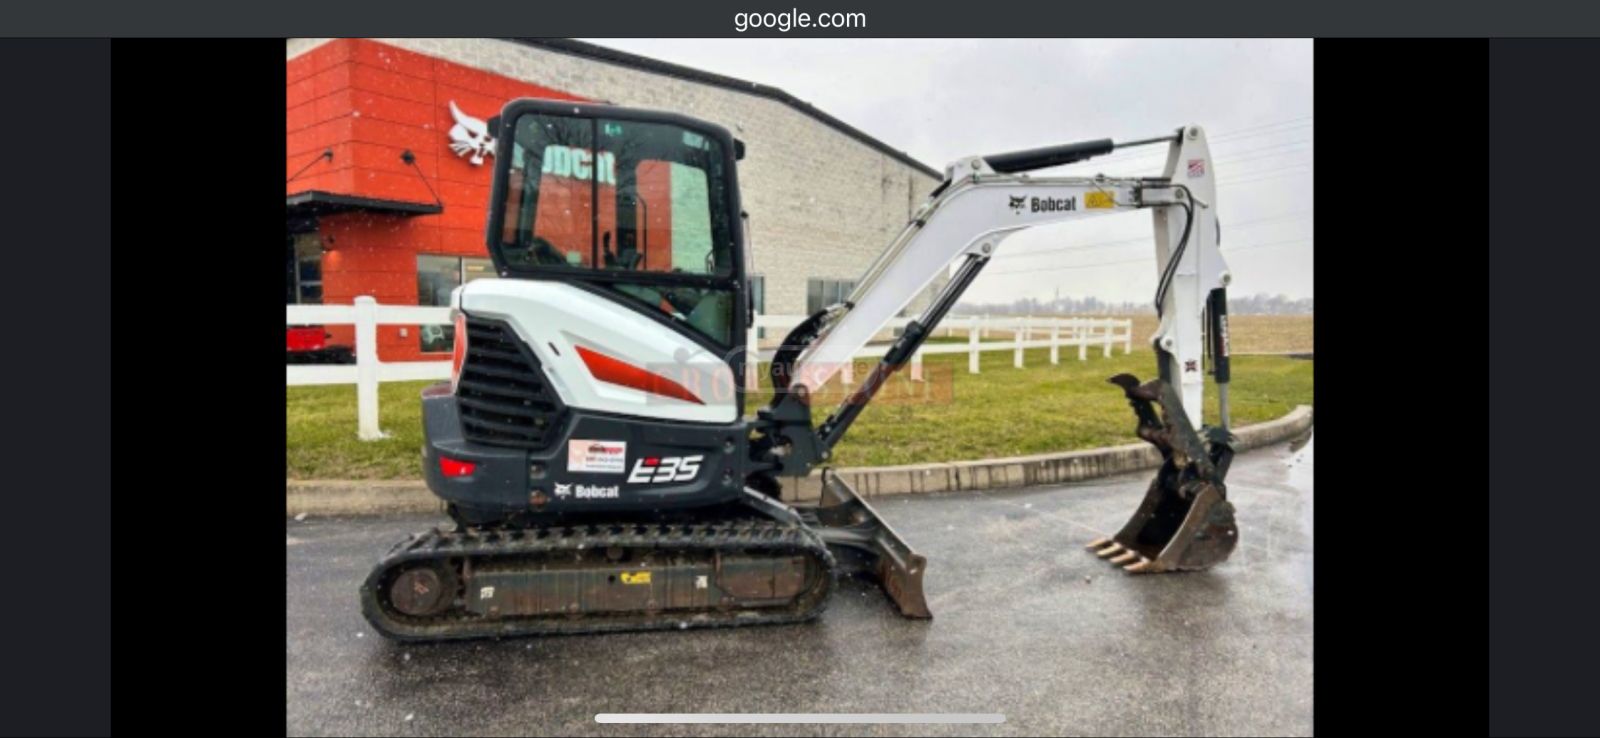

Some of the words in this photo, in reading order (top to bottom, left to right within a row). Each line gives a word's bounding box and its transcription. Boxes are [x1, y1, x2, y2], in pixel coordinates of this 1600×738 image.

[1031, 195, 1076, 213] Bobcat
[627, 455, 704, 483] E35
[575, 484, 619, 498] Bobcat
